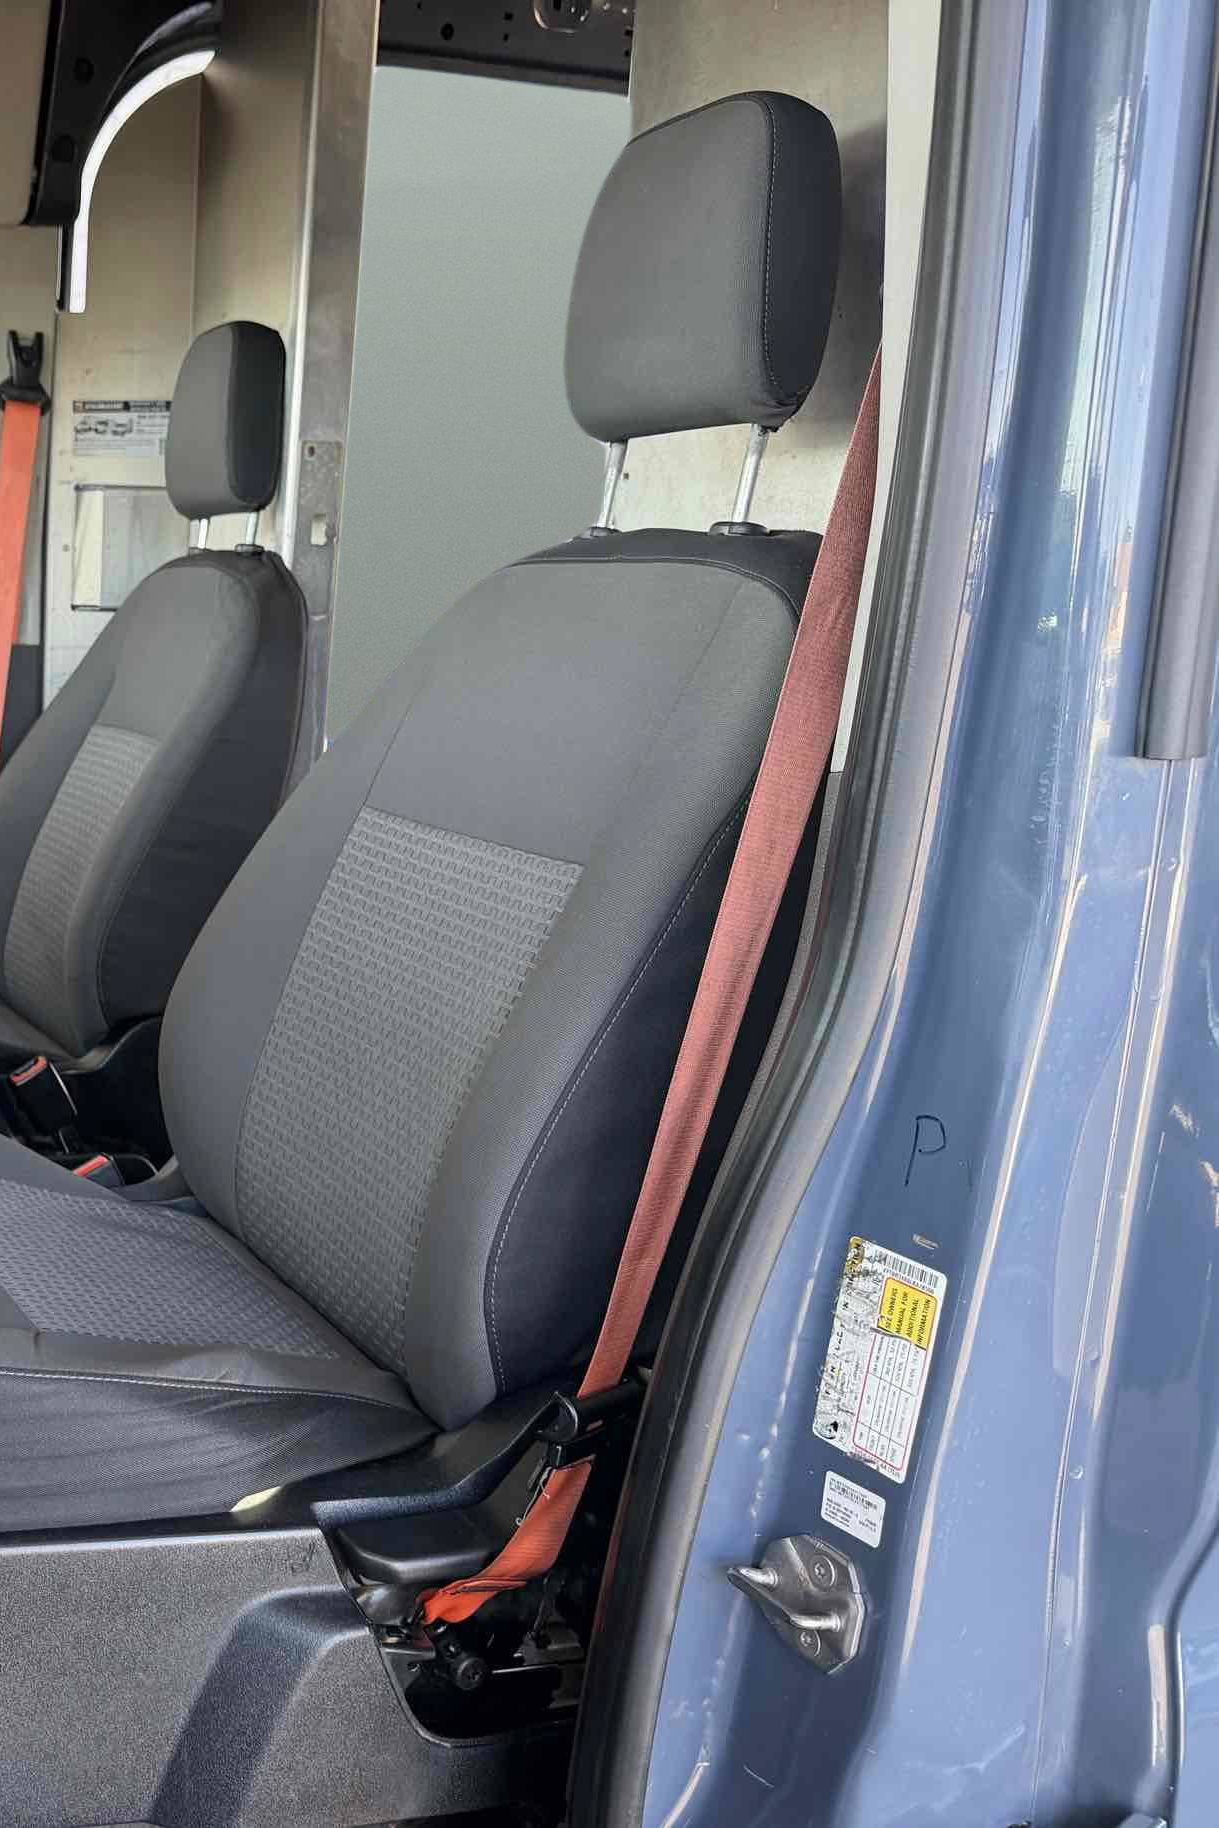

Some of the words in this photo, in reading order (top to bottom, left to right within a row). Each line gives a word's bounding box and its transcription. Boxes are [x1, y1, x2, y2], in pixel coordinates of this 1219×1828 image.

[904, 1114, 947, 1187] P
[895, 1308, 906, 1334] MANUAL
[905, 1299, 919, 1338] ADDITIONAL
[917, 1300, 931, 1344] INFORMATION
